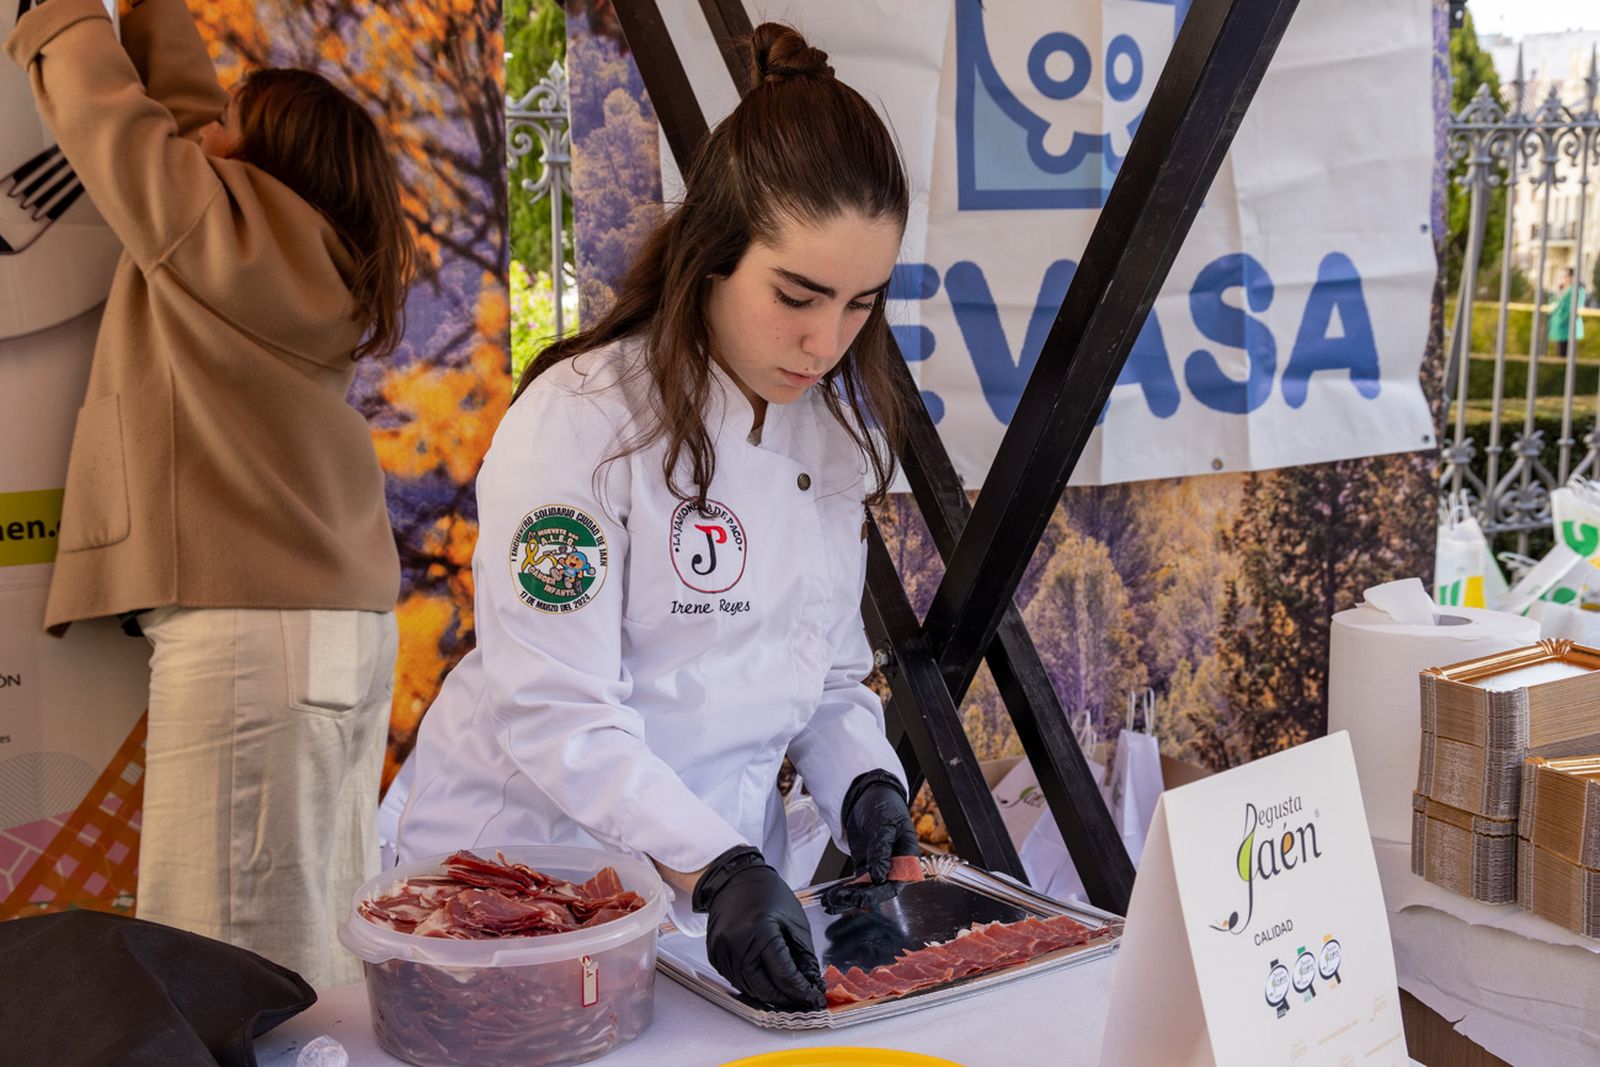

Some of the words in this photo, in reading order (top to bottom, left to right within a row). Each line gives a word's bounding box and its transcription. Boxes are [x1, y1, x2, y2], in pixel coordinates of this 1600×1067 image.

[511, 516, 534, 557] ENCUENTRO
[534, 507, 576, 520] SOLIDARIO
[576, 512, 600, 536] CIUDAD
[596, 535, 605, 546] DE
[673, 533, 681, 546] LA
[726, 517, 743, 545] PACO
[526, 596, 535, 606] DE
[535, 601, 559, 612] MARZO
[560, 603, 572, 612] DEL
[671, 600, 714, 614] Irene
[719, 599, 751, 616] Reyes
[1243, 796, 1303, 839] Degusta
[1254, 919, 1294, 946] CALIDAD
